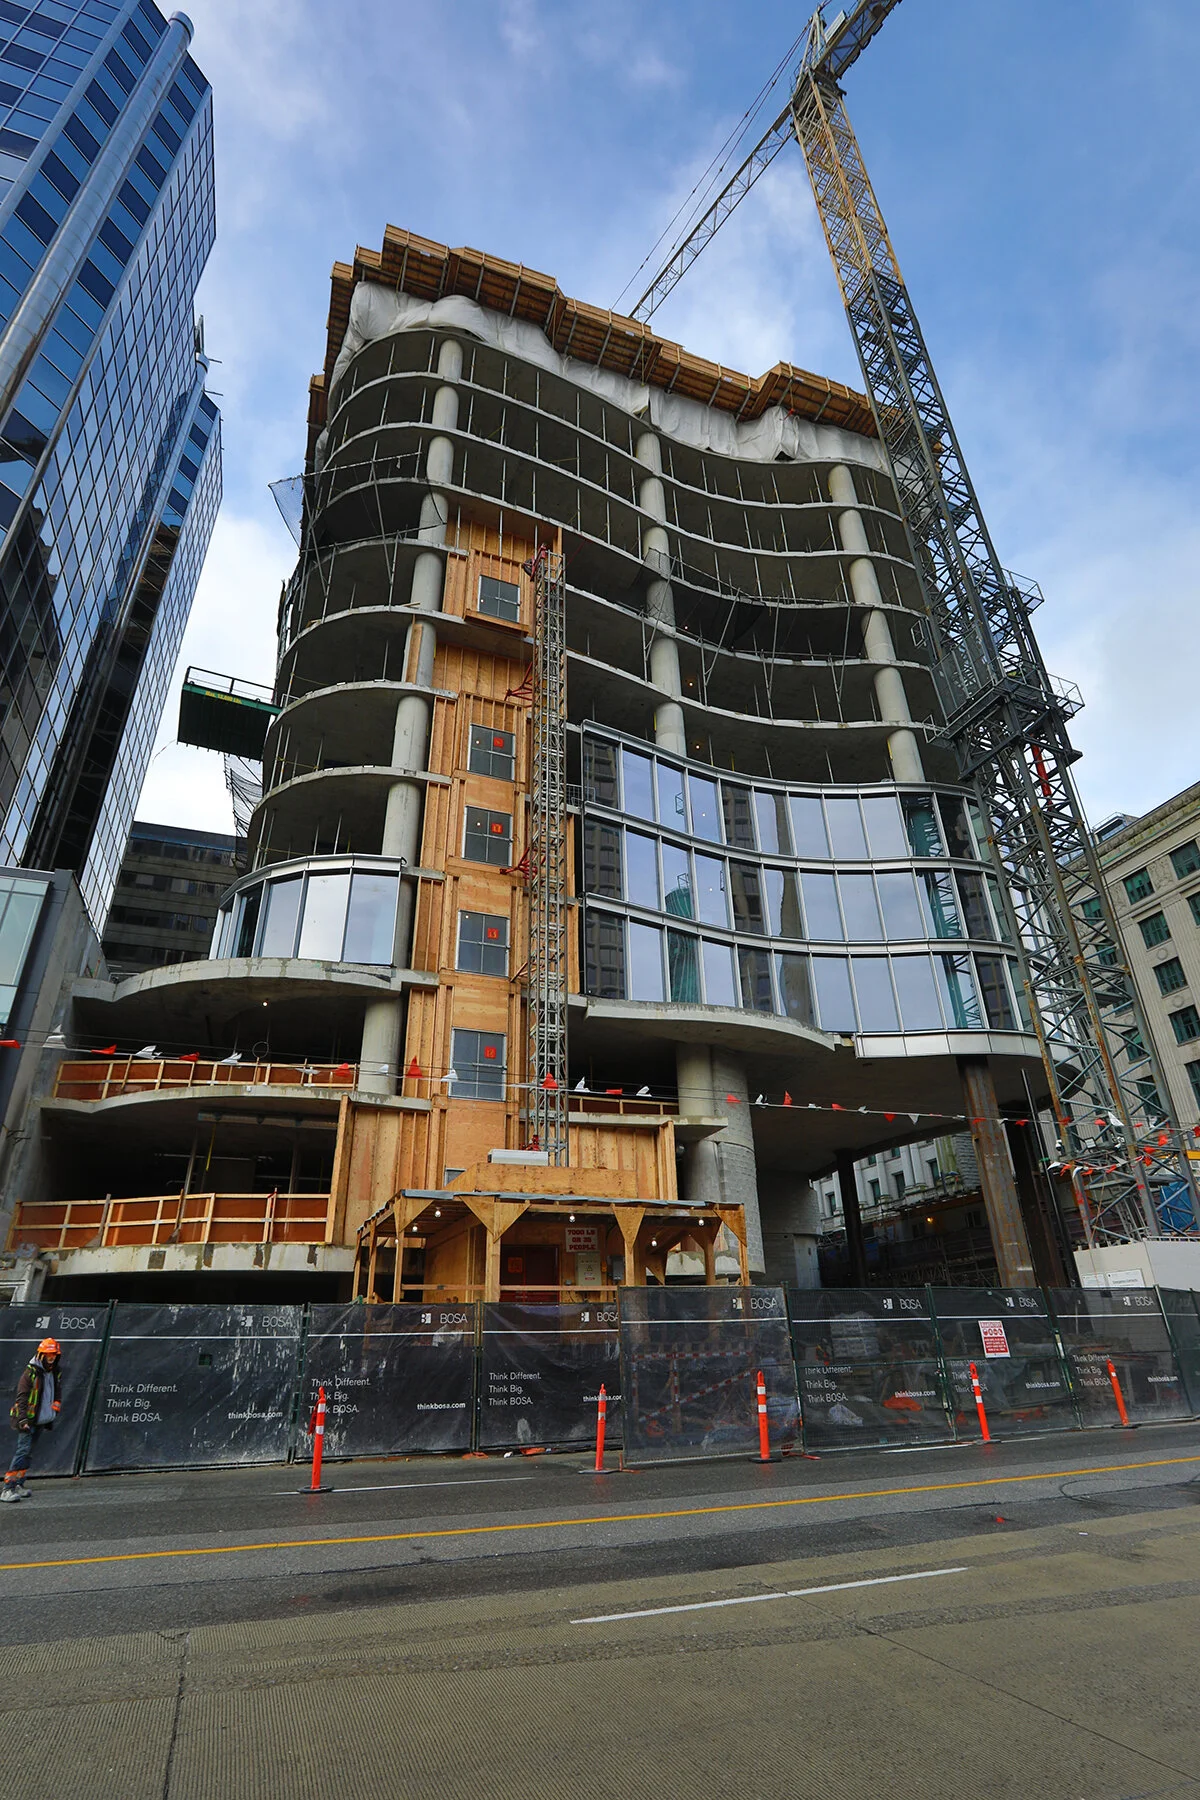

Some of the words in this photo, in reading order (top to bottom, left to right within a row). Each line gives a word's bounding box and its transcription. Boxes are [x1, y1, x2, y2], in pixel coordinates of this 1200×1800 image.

[750, 1297, 778, 1309] BOSA
[899, 1298, 922, 1310] BOSA
[1135, 1296, 1155, 1306] BOSA
[60, 1317, 96, 1330] BOSA
[262, 1316, 292, 1328] BOSA
[439, 1313, 468, 1324] BOSA
[488, 1372, 508, 1380] Think
[510, 1371, 542, 1380] Different.
[311, 1378, 333, 1387] Think
[335, 1377, 371, 1387] Different.
[805, 1379, 823, 1389] Think
[1025, 1381, 1060, 1389] thinkbosa.com
[109, 1383, 135, 1393] Think
[136, 1383, 178, 1393] Different.
[488, 1384, 508, 1393] Think
[510, 1384, 524, 1395] Big.
[310, 1391, 332, 1401] Thk
[334, 1391, 350, 1403] Big.
[807, 1394, 825, 1403] Think
[894, 1389, 936, 1398] thinkbosa.com
[107, 1398, 132, 1408] Think
[134, 1398, 152, 1410] Big.
[417, 1401, 466, 1410] thinkbosa.com
[488, 1397, 508, 1406] Think
[509, 1396, 534, 1406] BOSA.
[332, 1404, 360, 1414] BOSA.
[104, 1413, 129, 1423] Think
[131, 1412, 163, 1423] BOSA.
[228, 1410, 283, 1420] thinkbosa.com
